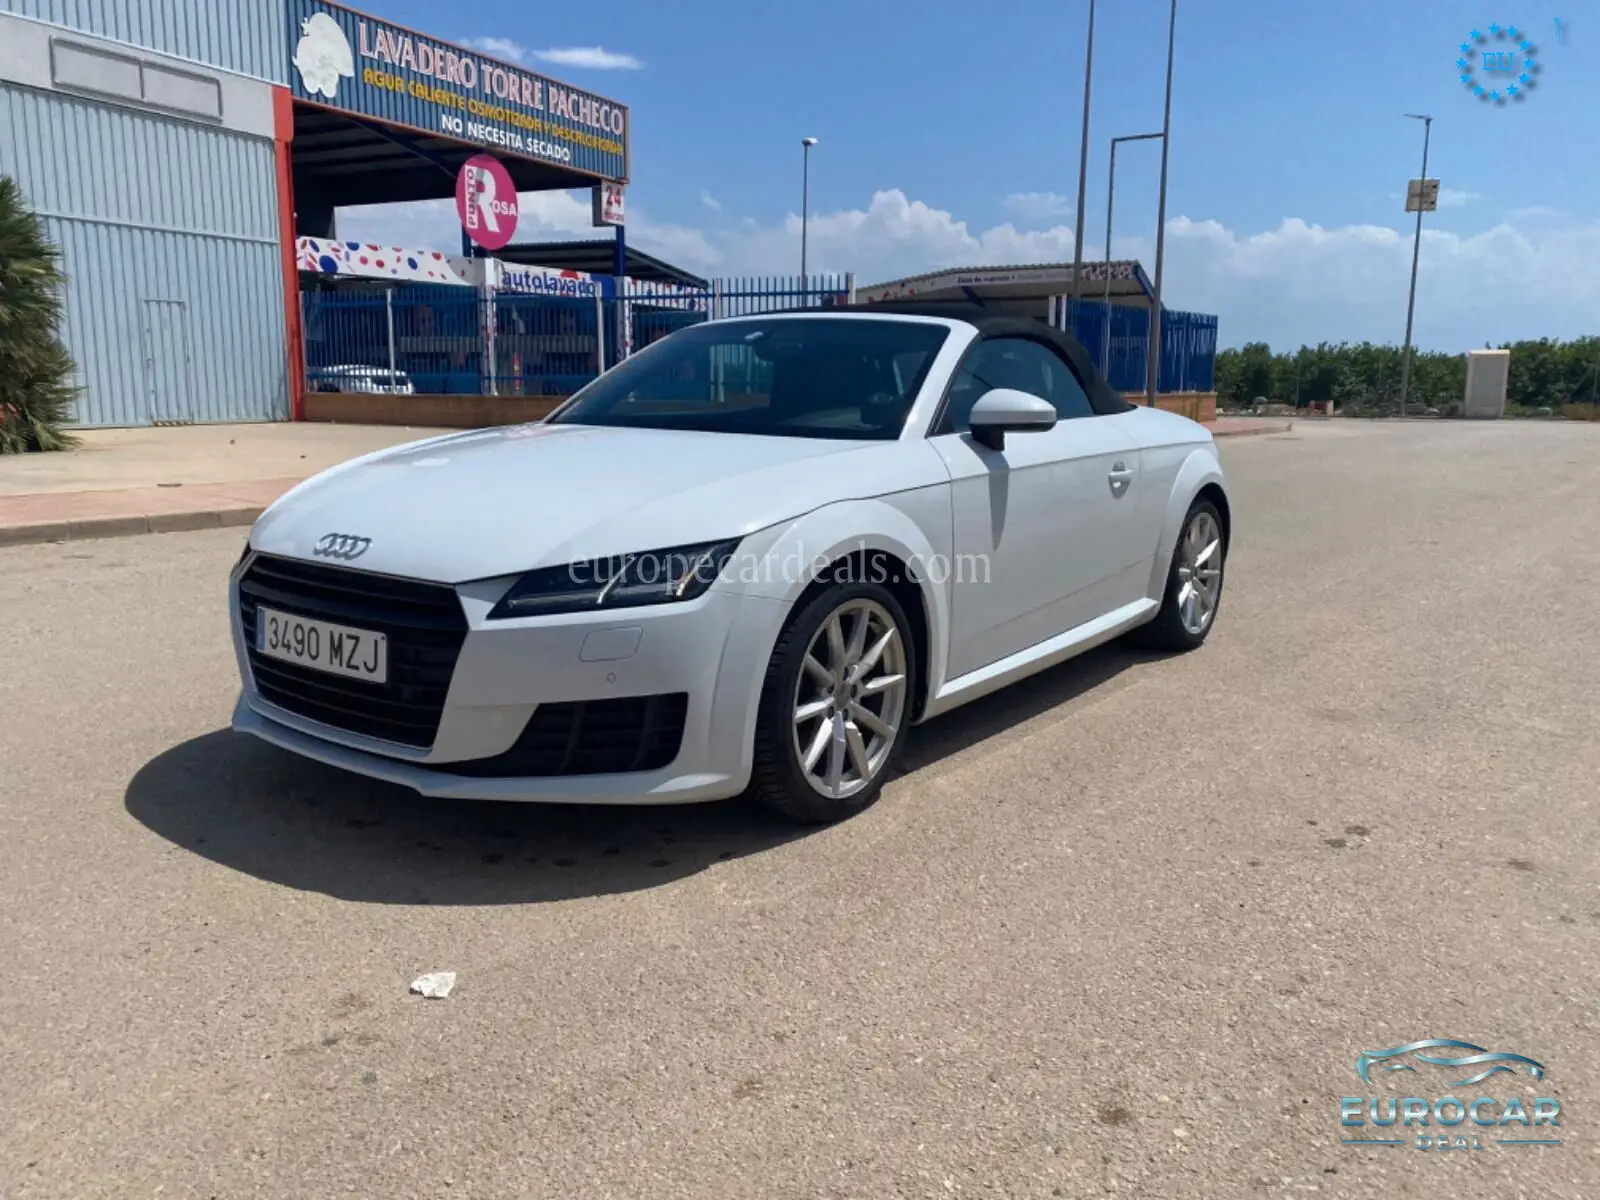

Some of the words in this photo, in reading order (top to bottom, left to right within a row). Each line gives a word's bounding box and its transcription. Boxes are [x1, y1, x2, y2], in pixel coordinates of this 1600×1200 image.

[359, 22, 476, 89] LAVADERO
[482, 63, 544, 110] TORRE
[548, 82, 625, 136] PACHECO
[363, 67, 404, 93] AGUA
[407, 80, 465, 111] CALIENTE
[442, 114, 463, 133] NO
[468, 123, 523, 150] NECESITA
[527, 138, 570, 161] SECADO
[502, 270, 596, 297] autolavado
[269, 617, 320, 661] 3490
[329, 630, 378, 673] MZJ
